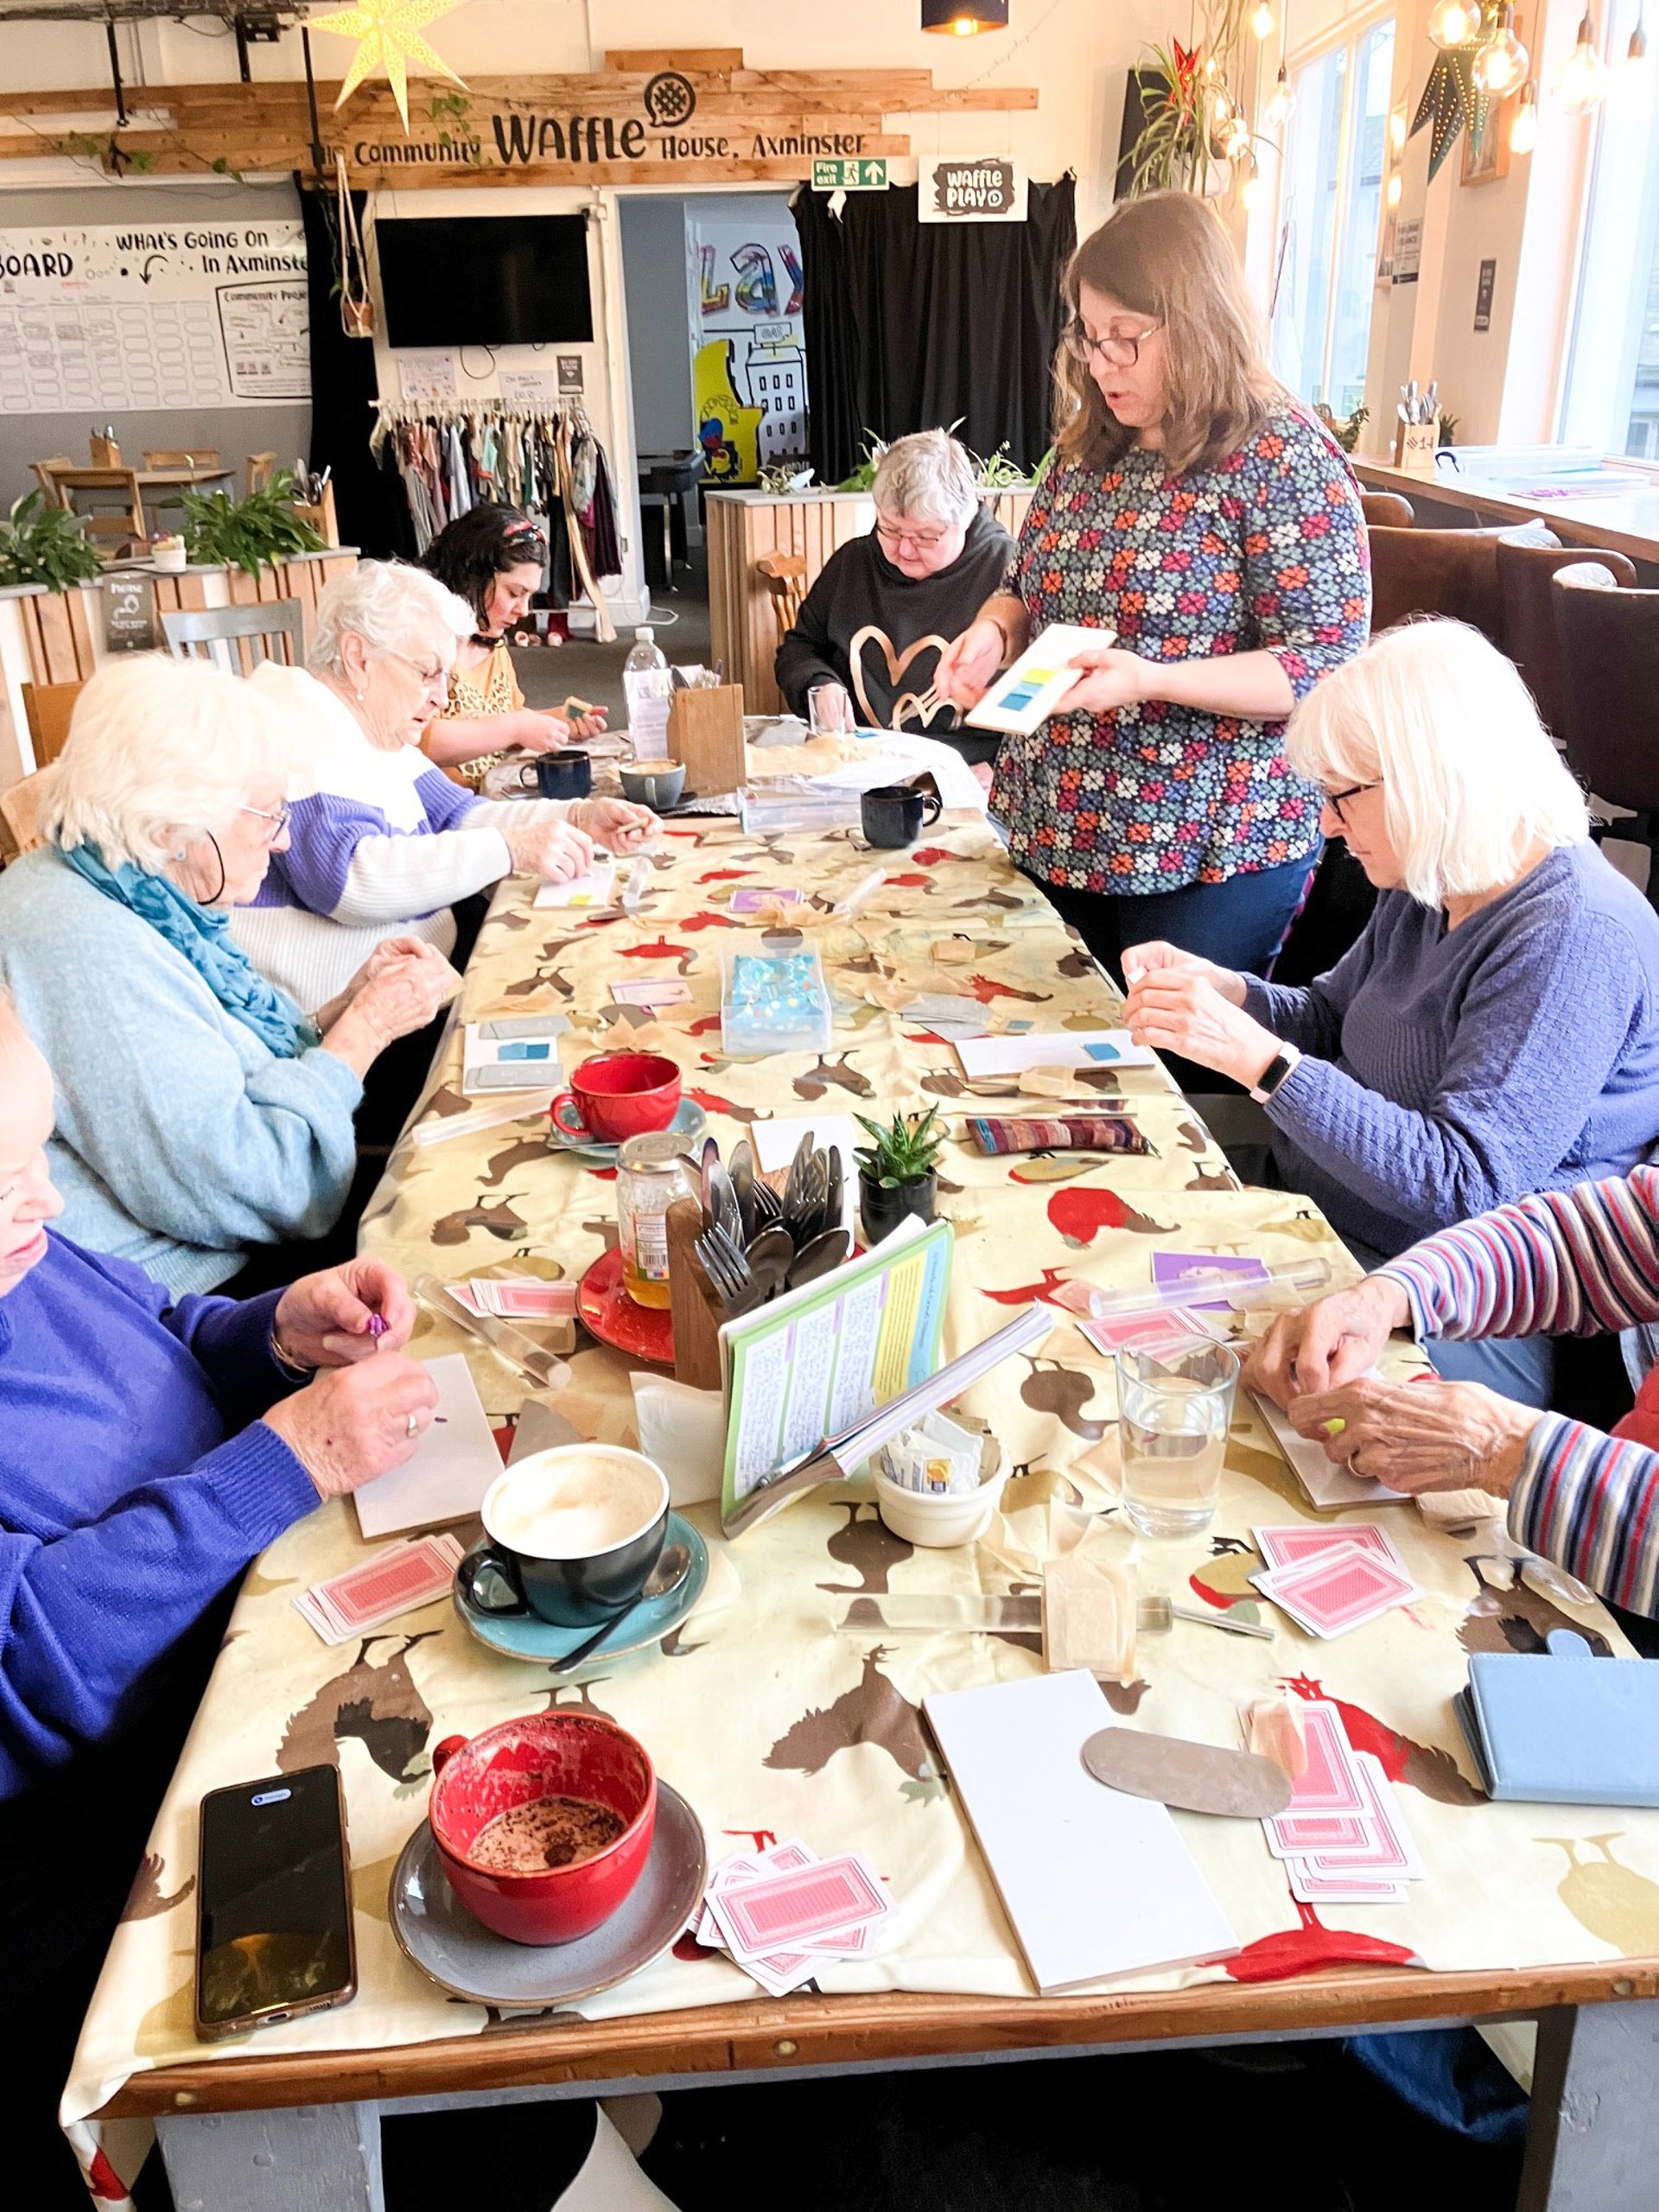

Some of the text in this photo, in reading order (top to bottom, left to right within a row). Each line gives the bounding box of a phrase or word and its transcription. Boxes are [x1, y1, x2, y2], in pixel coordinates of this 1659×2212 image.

[751, 134, 864, 159] Axminster
[816, 162, 838, 173] Fire
[816, 173, 837, 185] exit
[245, 230, 270, 248] On
[0, 252, 73, 277] OARD
